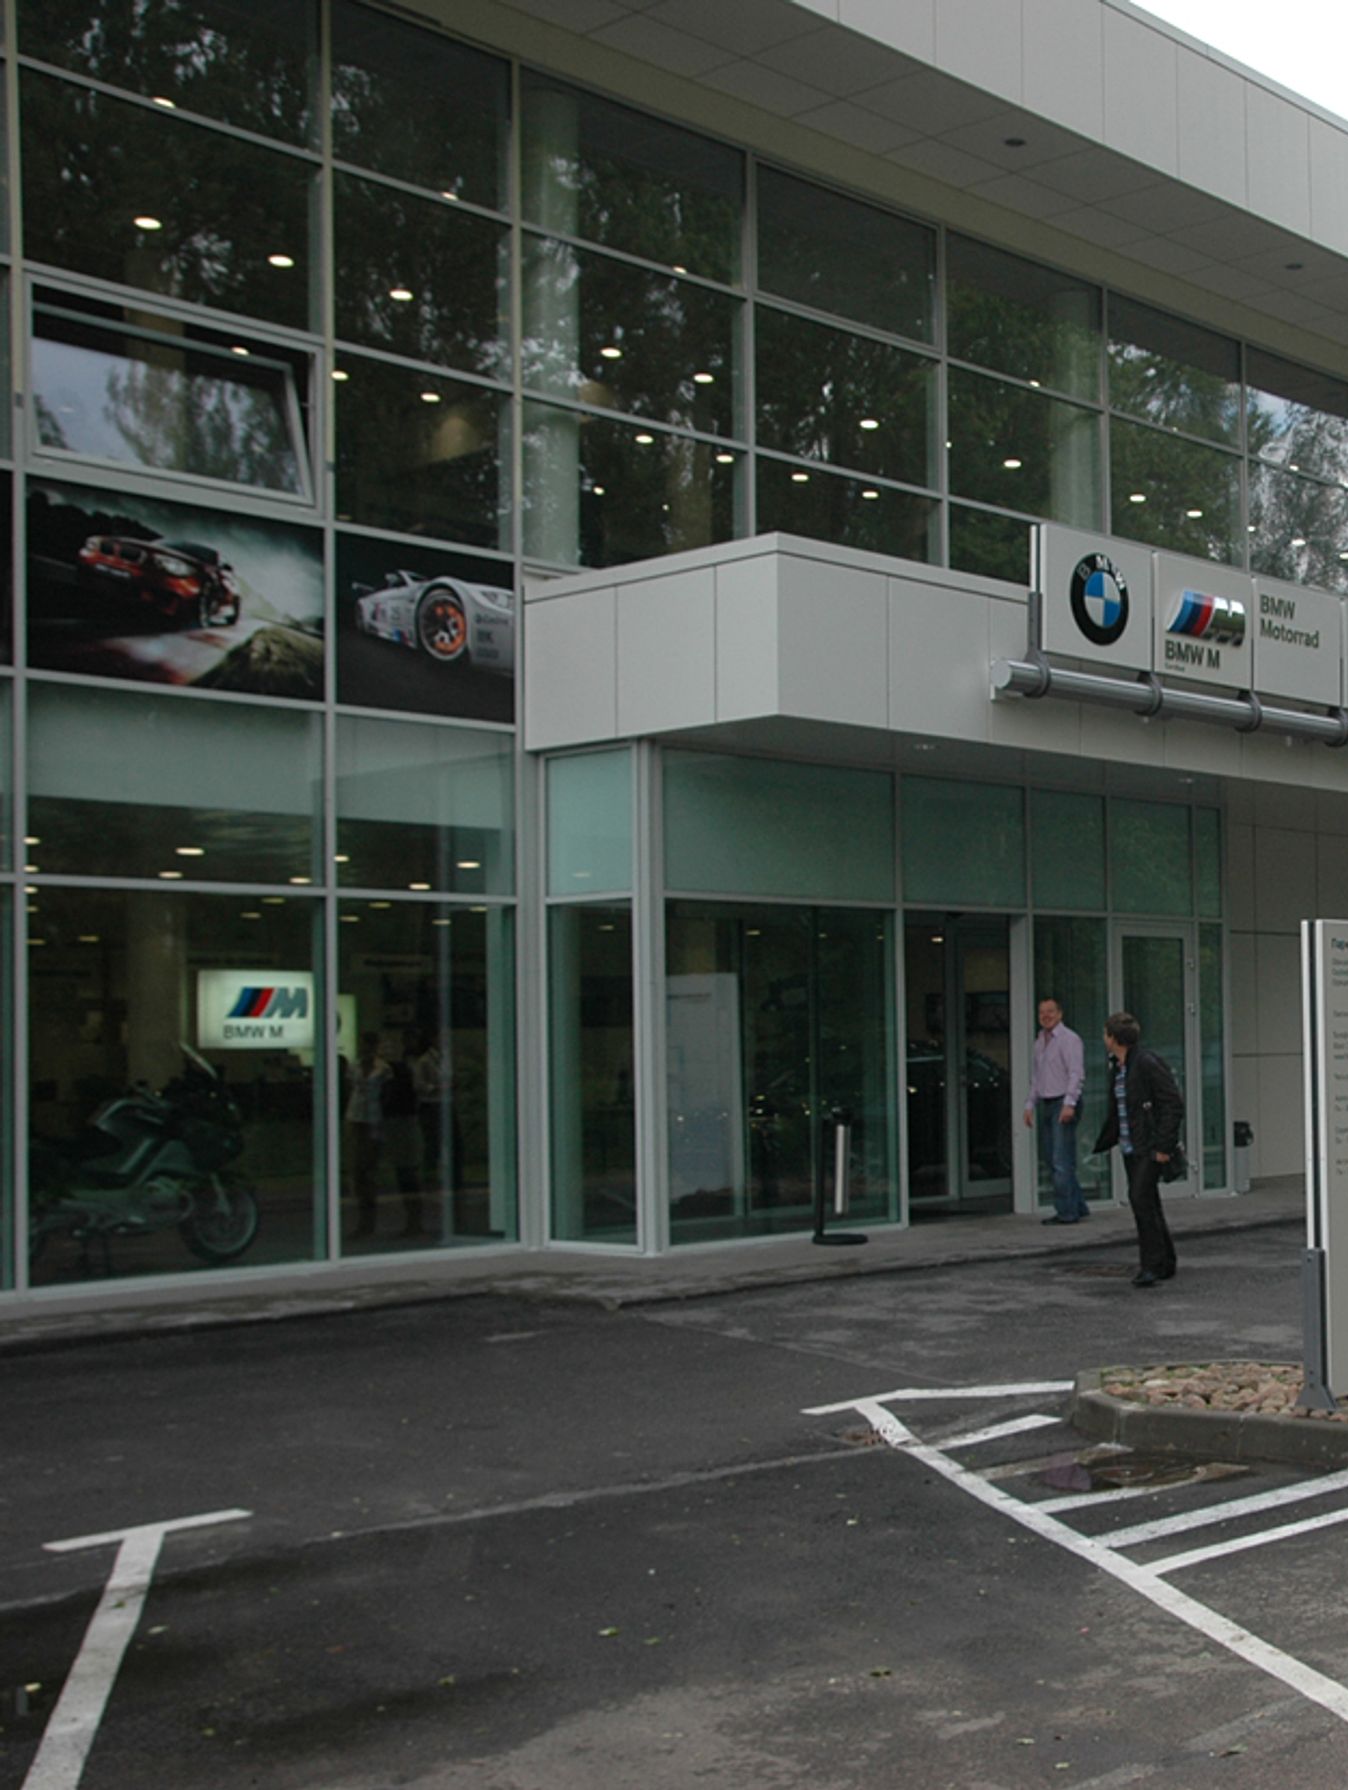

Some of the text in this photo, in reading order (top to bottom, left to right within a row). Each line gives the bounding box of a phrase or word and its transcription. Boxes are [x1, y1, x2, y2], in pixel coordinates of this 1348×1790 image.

[1077, 554, 1127, 591] BMW
[1260, 594, 1296, 621] BMW
[1260, 620, 1320, 649] Motorrad
[1165, 639, 1204, 666] BMW
[1206, 648, 1220, 669] M
[223, 1024, 284, 1039] BMW M
